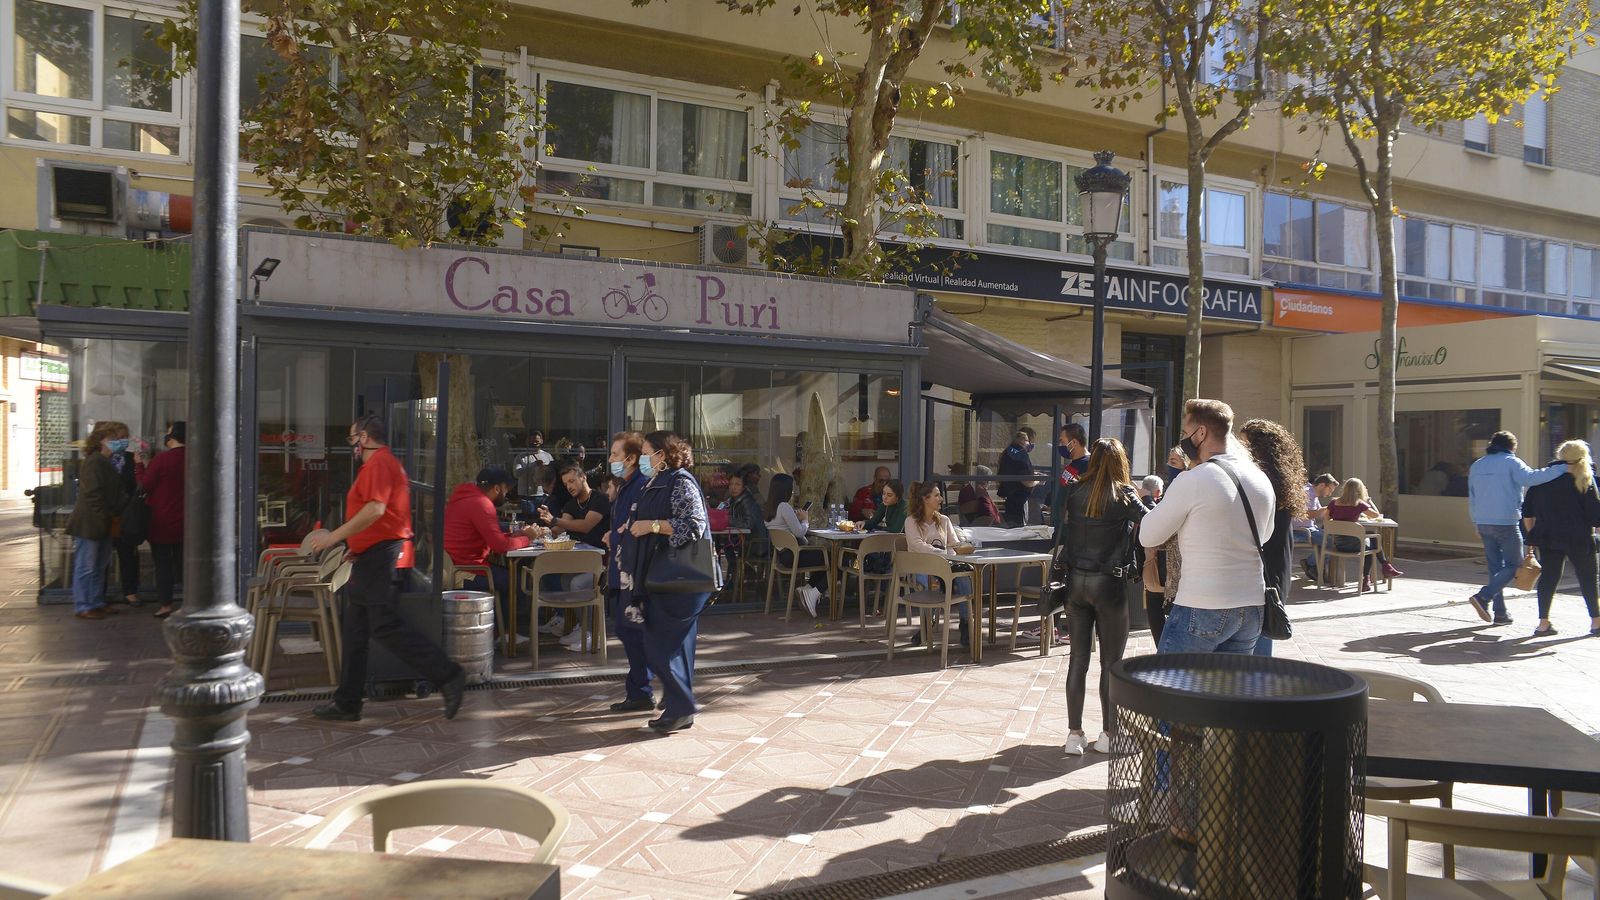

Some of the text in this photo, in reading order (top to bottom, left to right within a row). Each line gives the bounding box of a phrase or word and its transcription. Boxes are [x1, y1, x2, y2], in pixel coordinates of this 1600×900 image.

[882, 271, 913, 282] ealidad
[915, 273, 939, 285] Virtual
[945, 277, 976, 288] Realidad
[978, 280, 1019, 292] Aumentada
[445, 256, 780, 329] Casa Puri
[1280, 298, 1334, 315] Ciudadanos
